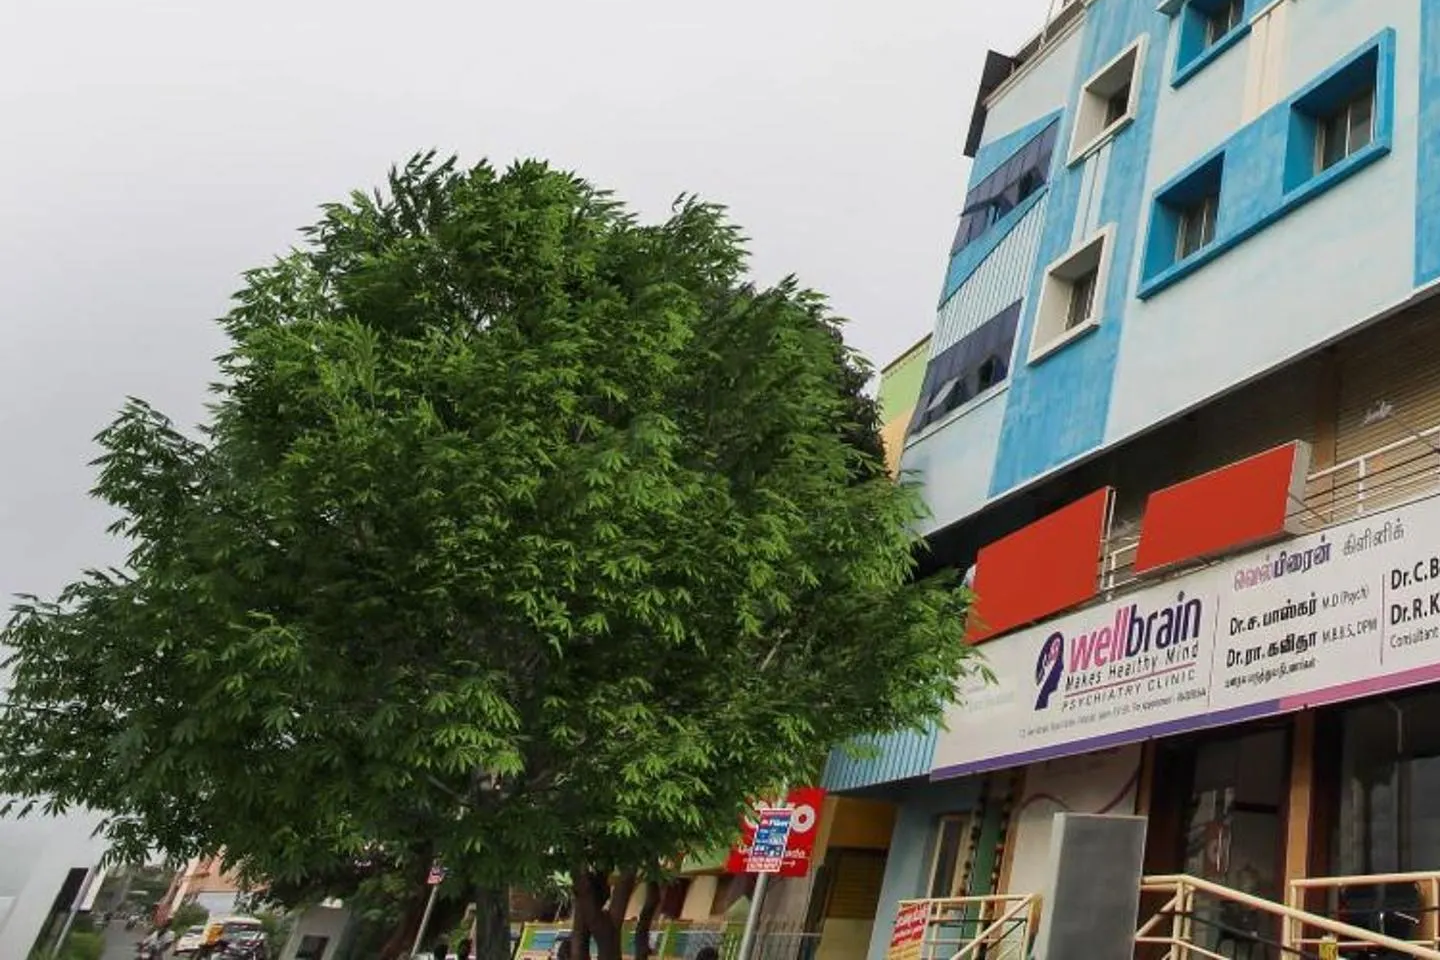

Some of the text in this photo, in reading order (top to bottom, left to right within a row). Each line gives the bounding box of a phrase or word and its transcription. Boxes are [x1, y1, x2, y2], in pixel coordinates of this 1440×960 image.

[1069, 590, 1202, 673] wellbrain
[1389, 625, 1440, 649] Consultant
[1066, 641, 1200, 691] Makes Healthy Mind
[1061, 669, 1196, 713] PSYCHIATRY CLINIC
